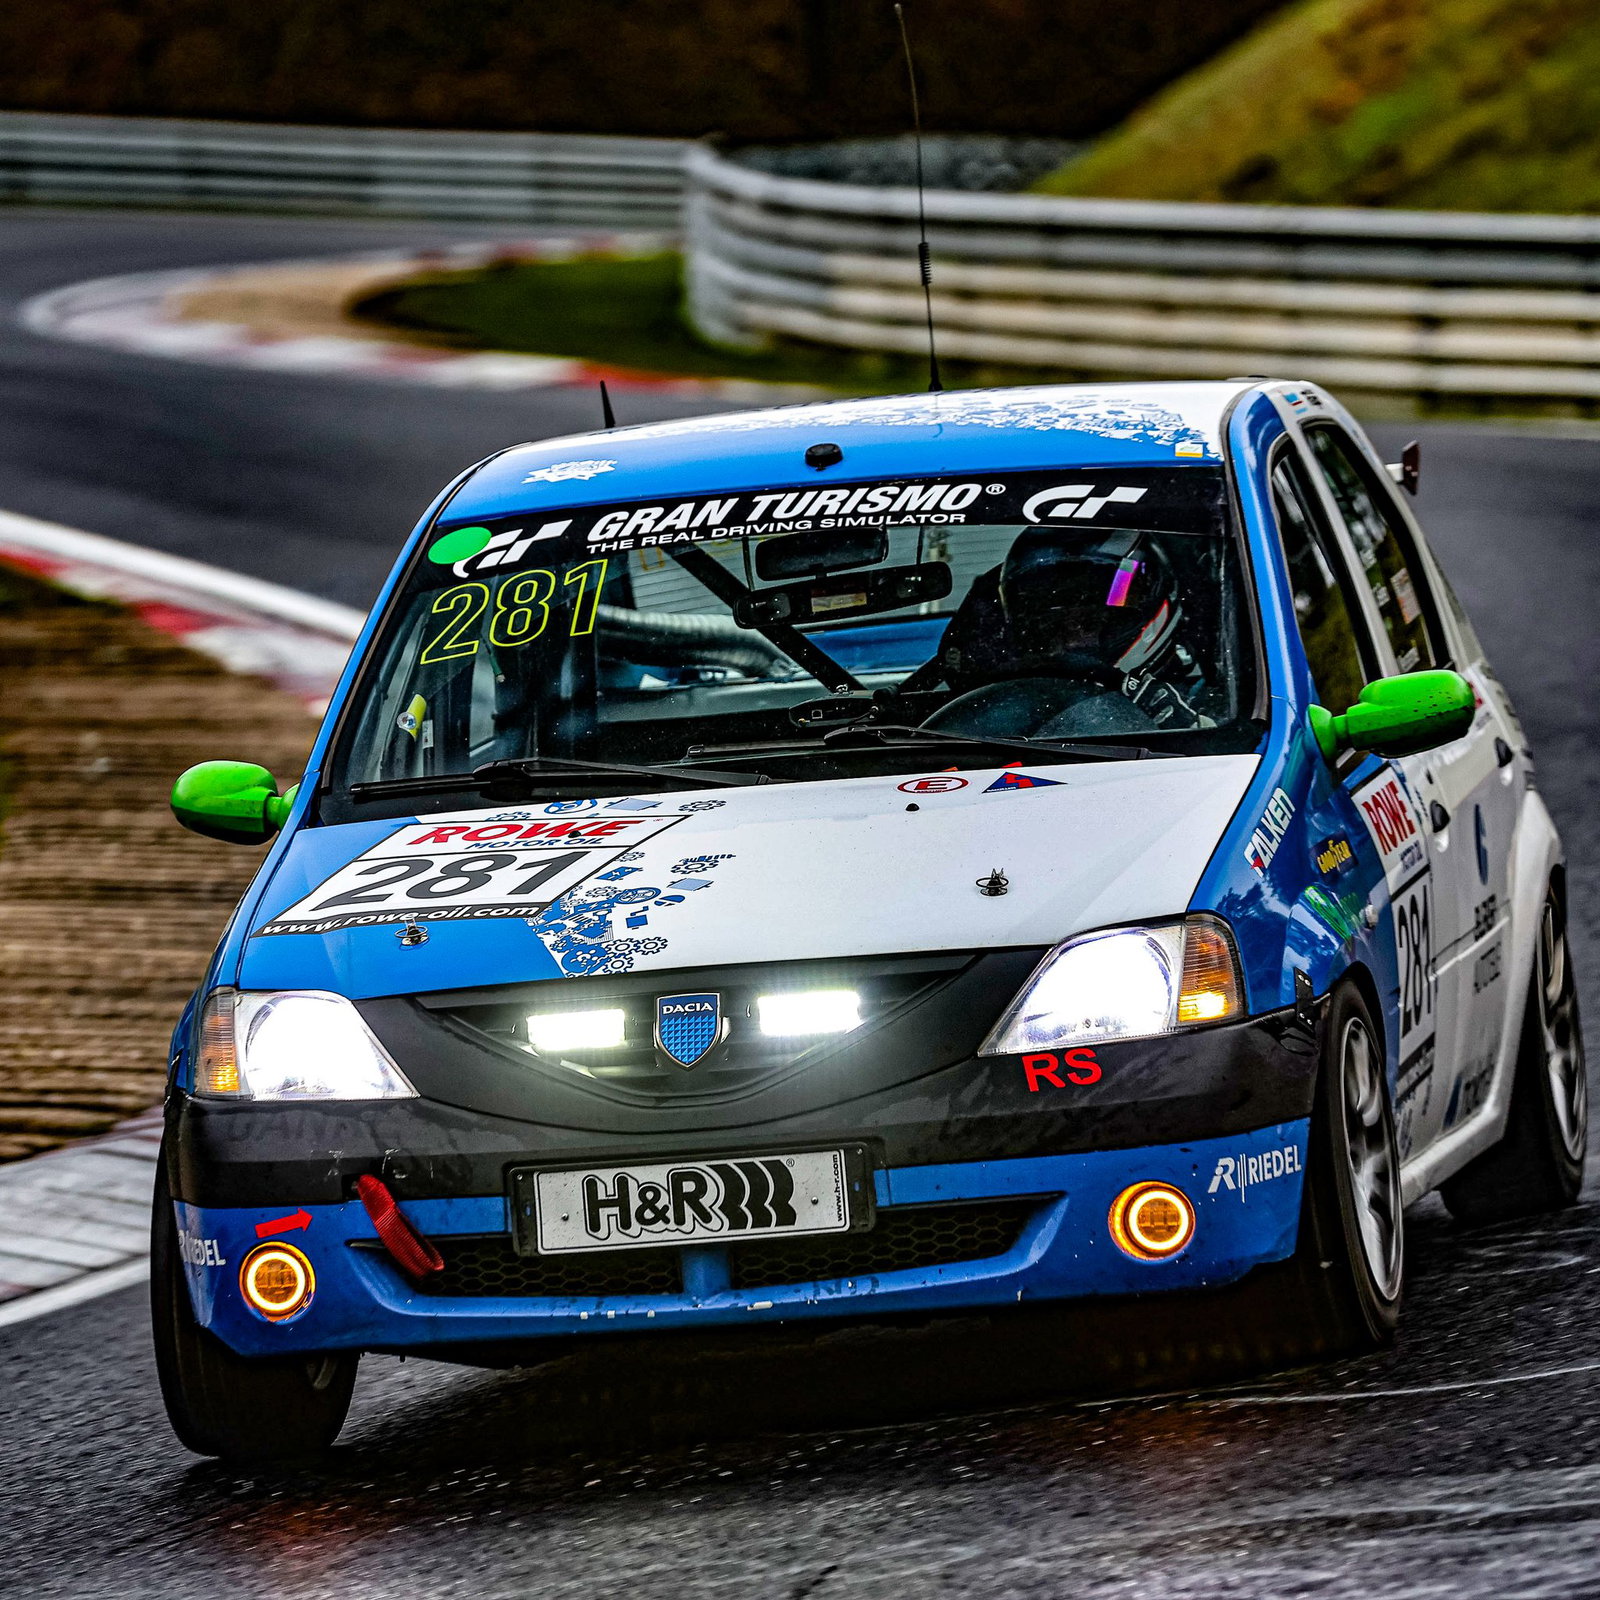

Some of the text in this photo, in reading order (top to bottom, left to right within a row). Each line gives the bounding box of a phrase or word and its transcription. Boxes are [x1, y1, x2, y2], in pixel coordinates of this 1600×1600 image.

[586, 497, 740, 542] GRAN
[586, 513, 967, 555] THE REAL DRIVING SIMULATOR
[420, 558, 609, 665] 281
[406, 819, 647, 846] ROWE
[1243, 786, 1297, 878] FALKEN
[1361, 780, 1417, 856] ROWE
[464, 836, 606, 850] MOTOR OIL
[309, 850, 592, 912] 281
[261, 904, 542, 935] www.rowe-oil.com
[1397, 884, 1432, 1039] 281
[662, 1002, 714, 1015] DACIA
[1021, 1047, 1103, 1092] RS
[831, 1153, 846, 1222] www.h-r.com
[1248, 1144, 1303, 1186] RIEDEL
[583, 1167, 726, 1240] H&R
